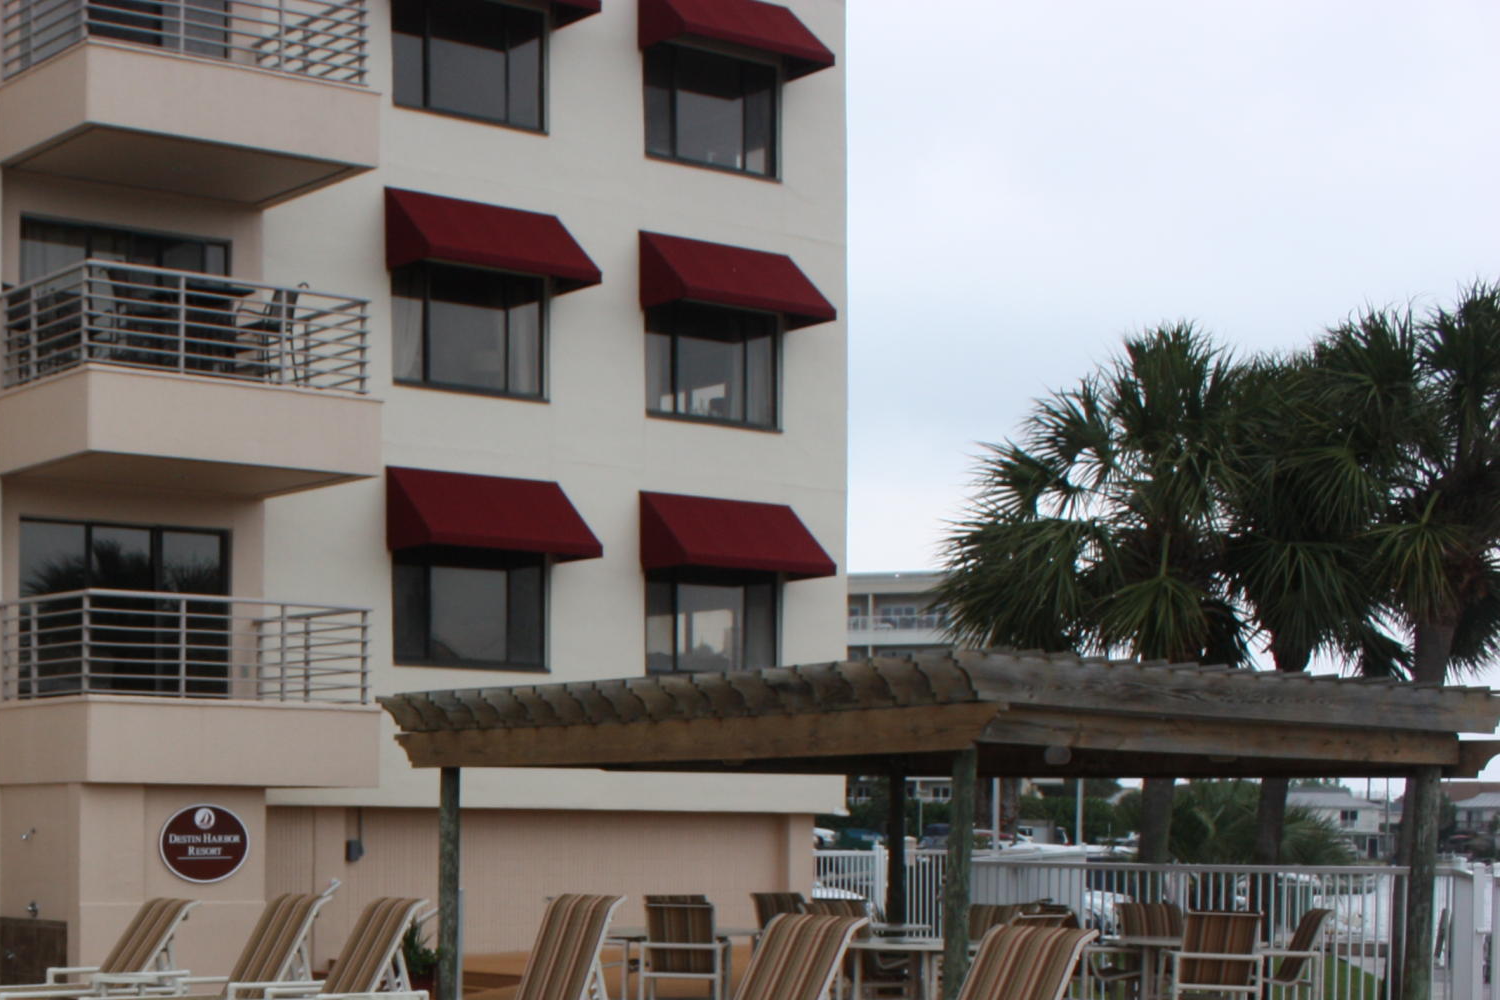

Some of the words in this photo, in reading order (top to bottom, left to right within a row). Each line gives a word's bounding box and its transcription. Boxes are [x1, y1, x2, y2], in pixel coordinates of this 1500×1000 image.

[169, 834, 201, 844] DESTIN
[203, 833, 240, 843] HARBOR
[188, 846, 222, 856] RESORT
